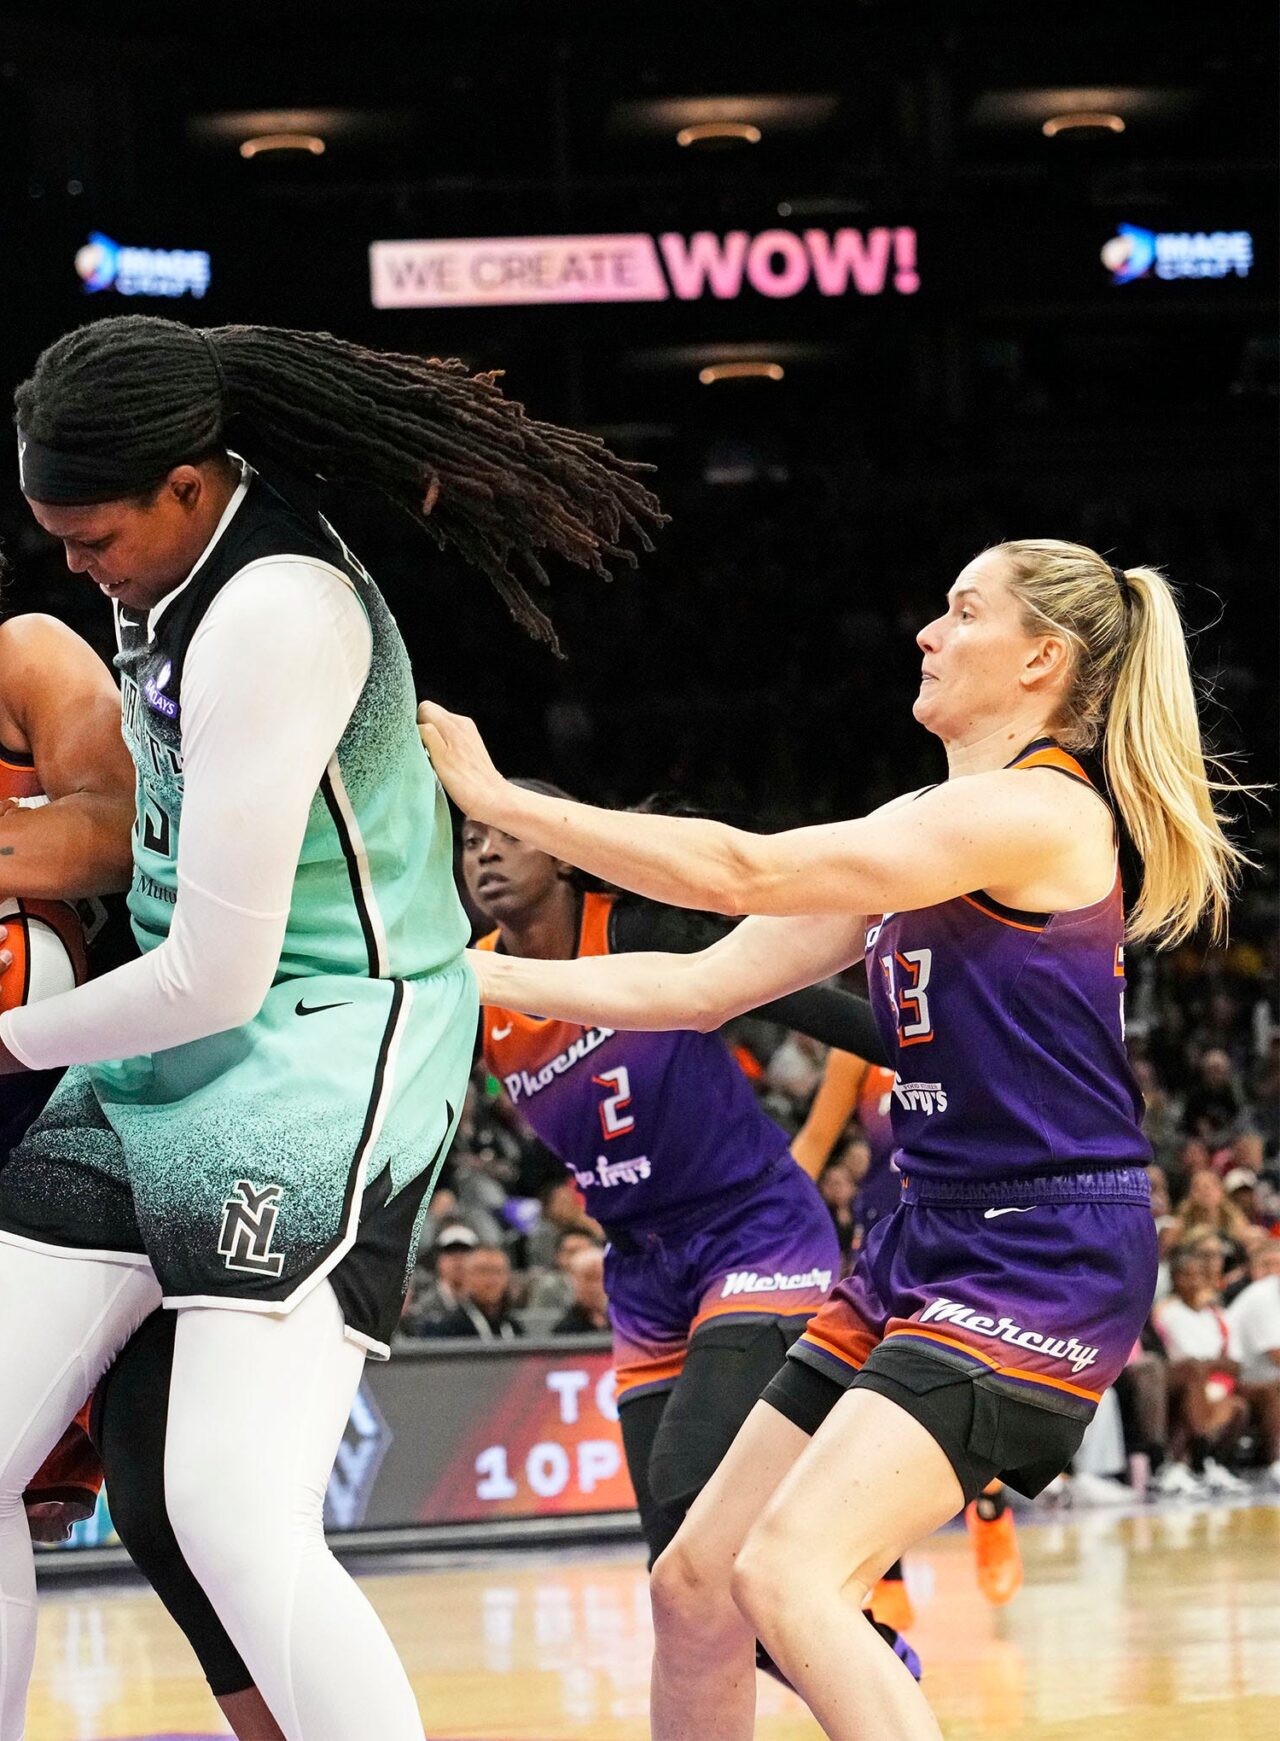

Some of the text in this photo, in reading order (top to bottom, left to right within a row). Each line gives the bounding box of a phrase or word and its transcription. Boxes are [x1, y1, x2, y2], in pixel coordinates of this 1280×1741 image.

[384, 226, 921, 301] WE CREATE WOW!
[592, 1065, 636, 1141] 2
[720, 1267, 833, 1300] Mercury
[919, 1297, 1100, 1373] Mercury
